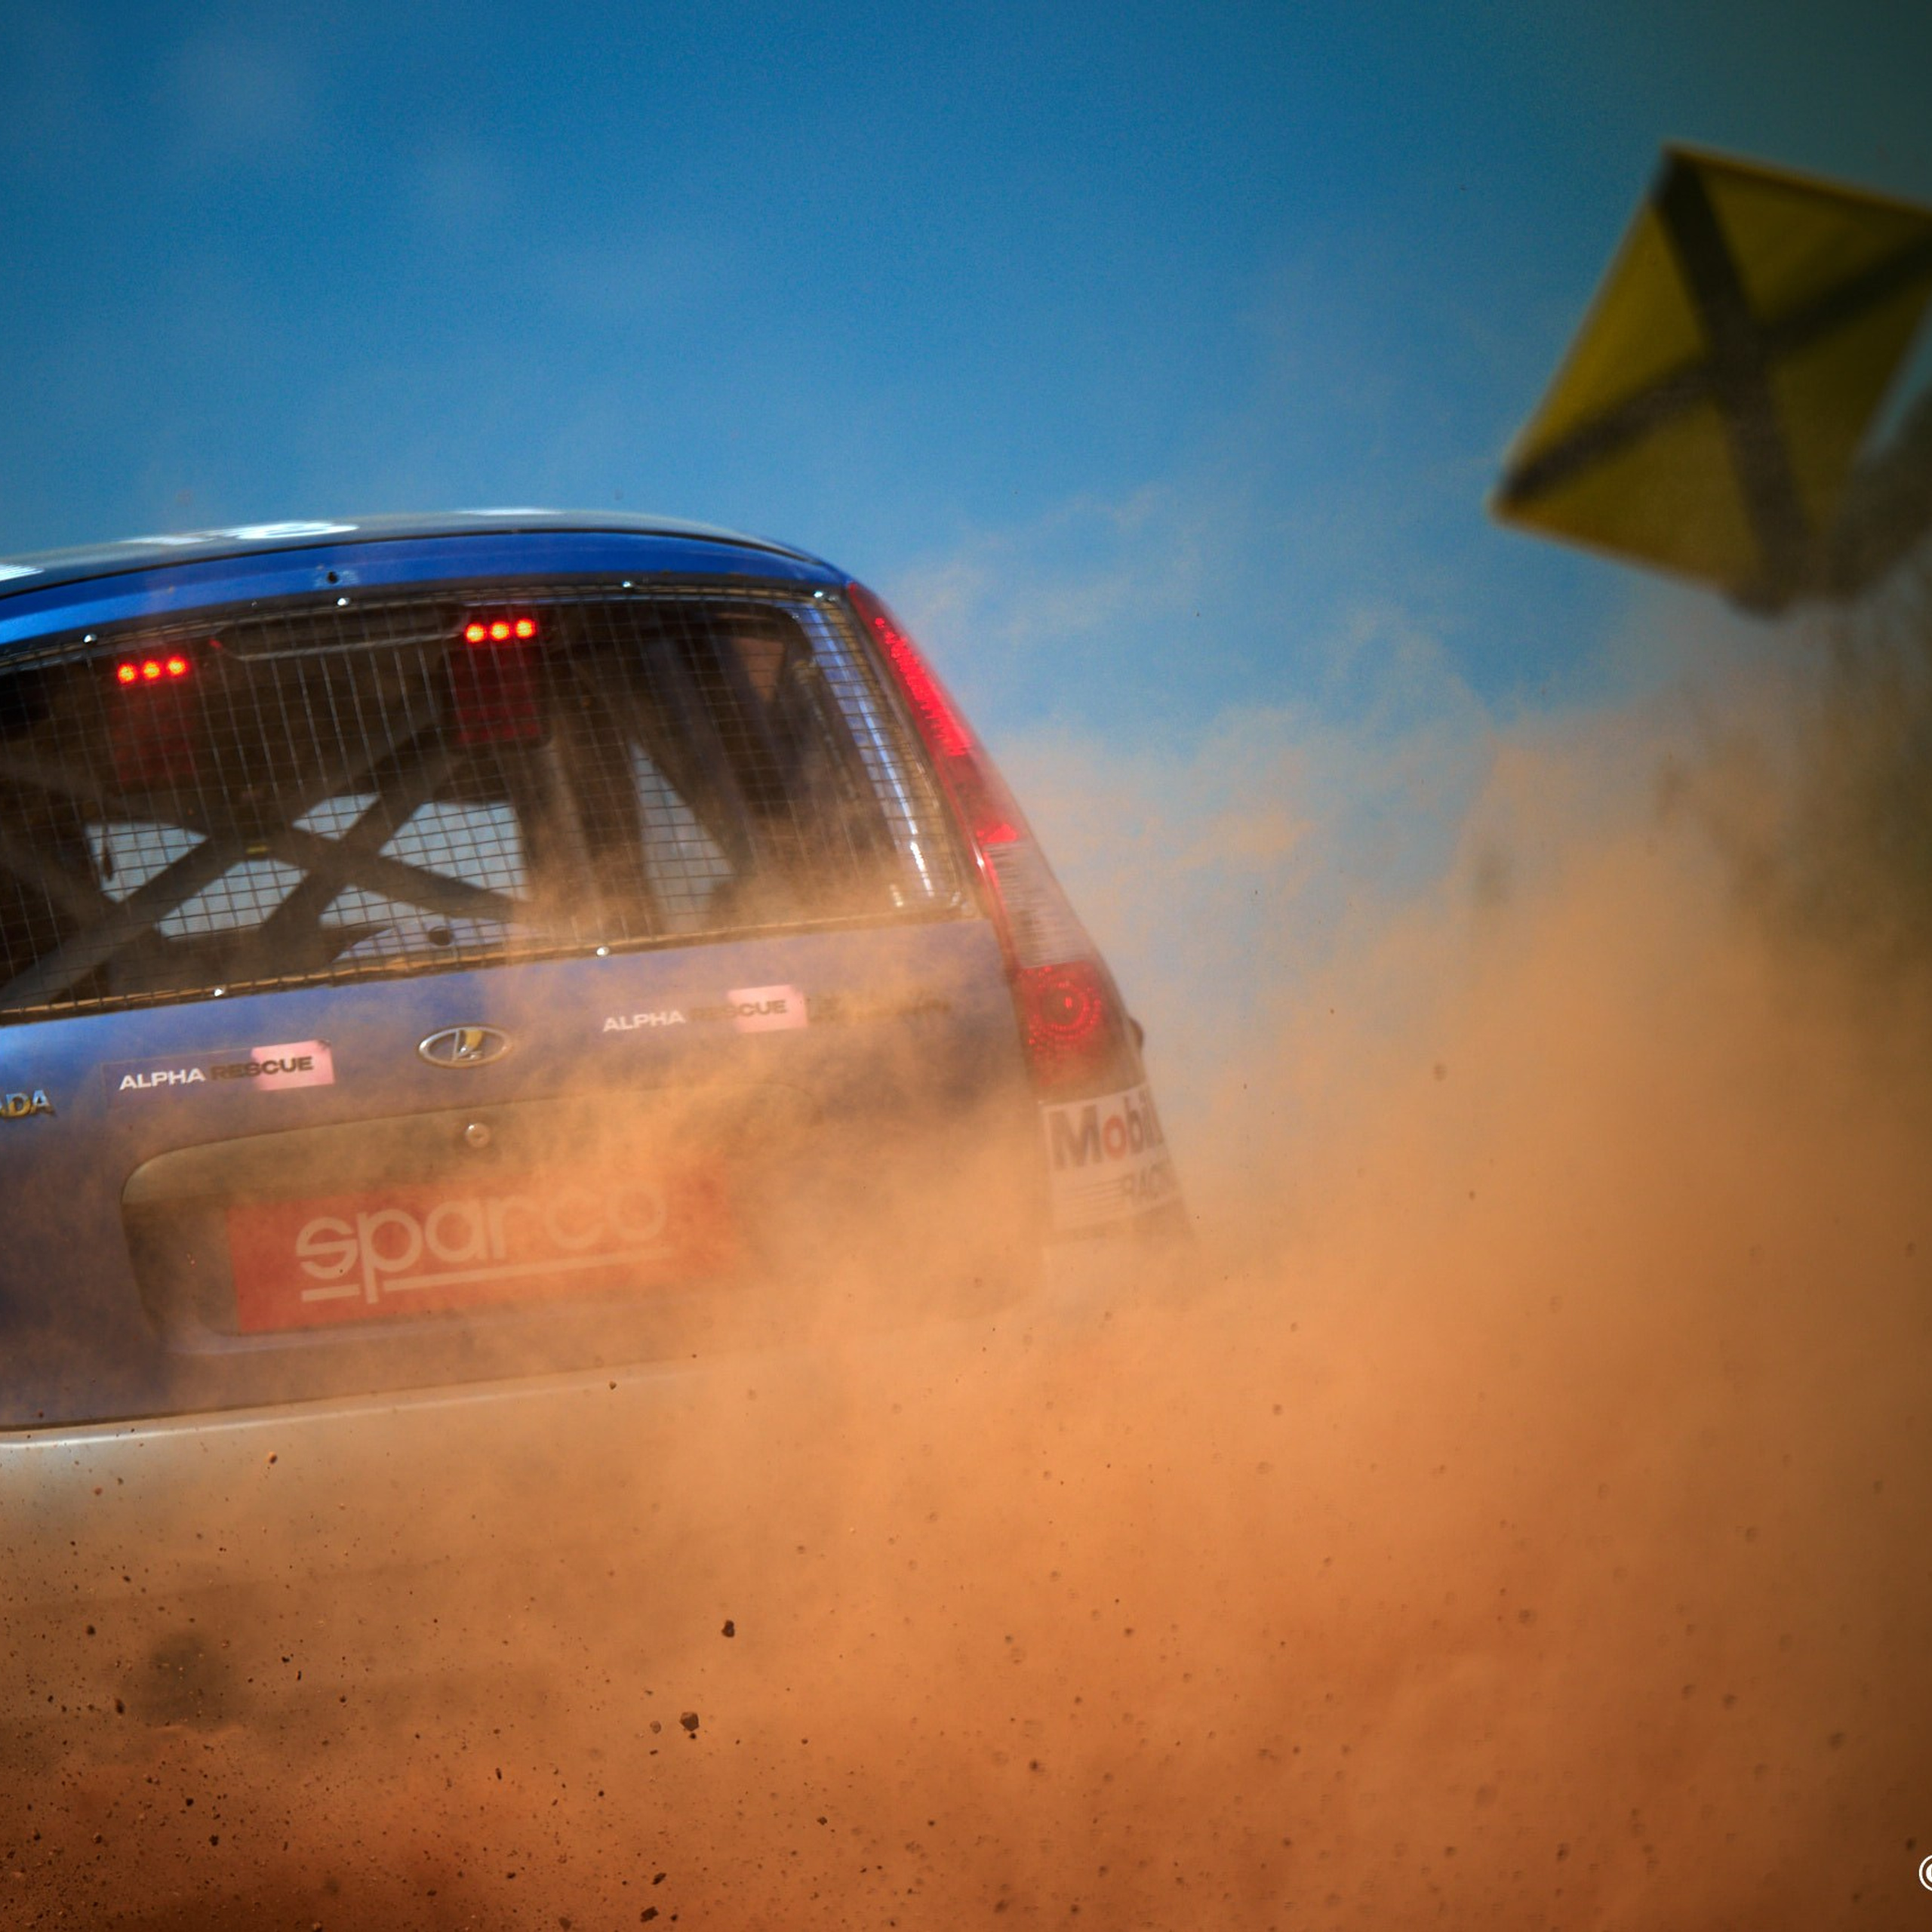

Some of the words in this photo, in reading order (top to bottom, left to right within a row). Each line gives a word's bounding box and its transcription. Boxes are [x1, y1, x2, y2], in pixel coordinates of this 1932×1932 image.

[602, 1010, 687, 1032] ALPHA
[119, 1068, 205, 1091] ALPHA
[211, 1056, 313, 1081] RESCUE
[296, 1186, 669, 1304] sparco
